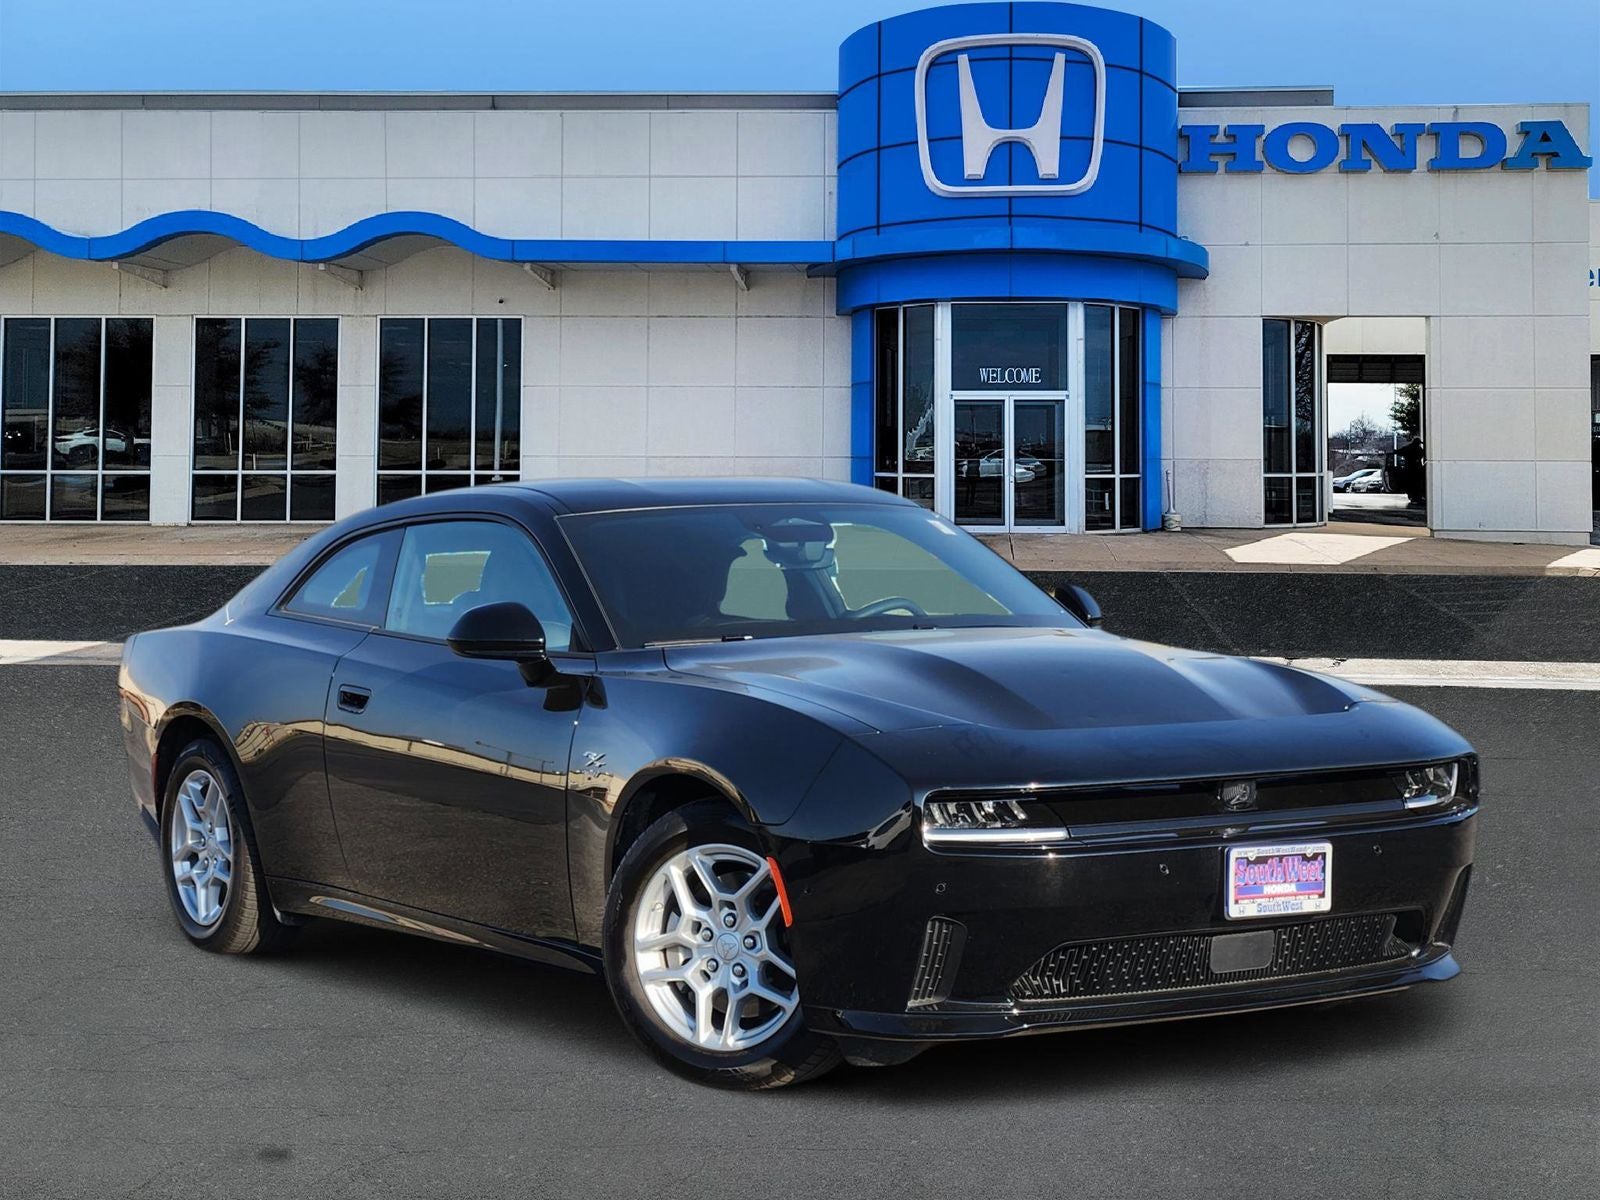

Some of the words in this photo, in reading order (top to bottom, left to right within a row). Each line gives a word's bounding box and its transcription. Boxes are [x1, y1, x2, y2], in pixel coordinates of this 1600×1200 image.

[1179, 121, 1592, 174] HONDA
[979, 367, 1042, 384] WELCOME
[1235, 855, 1325, 885] SouthWest
